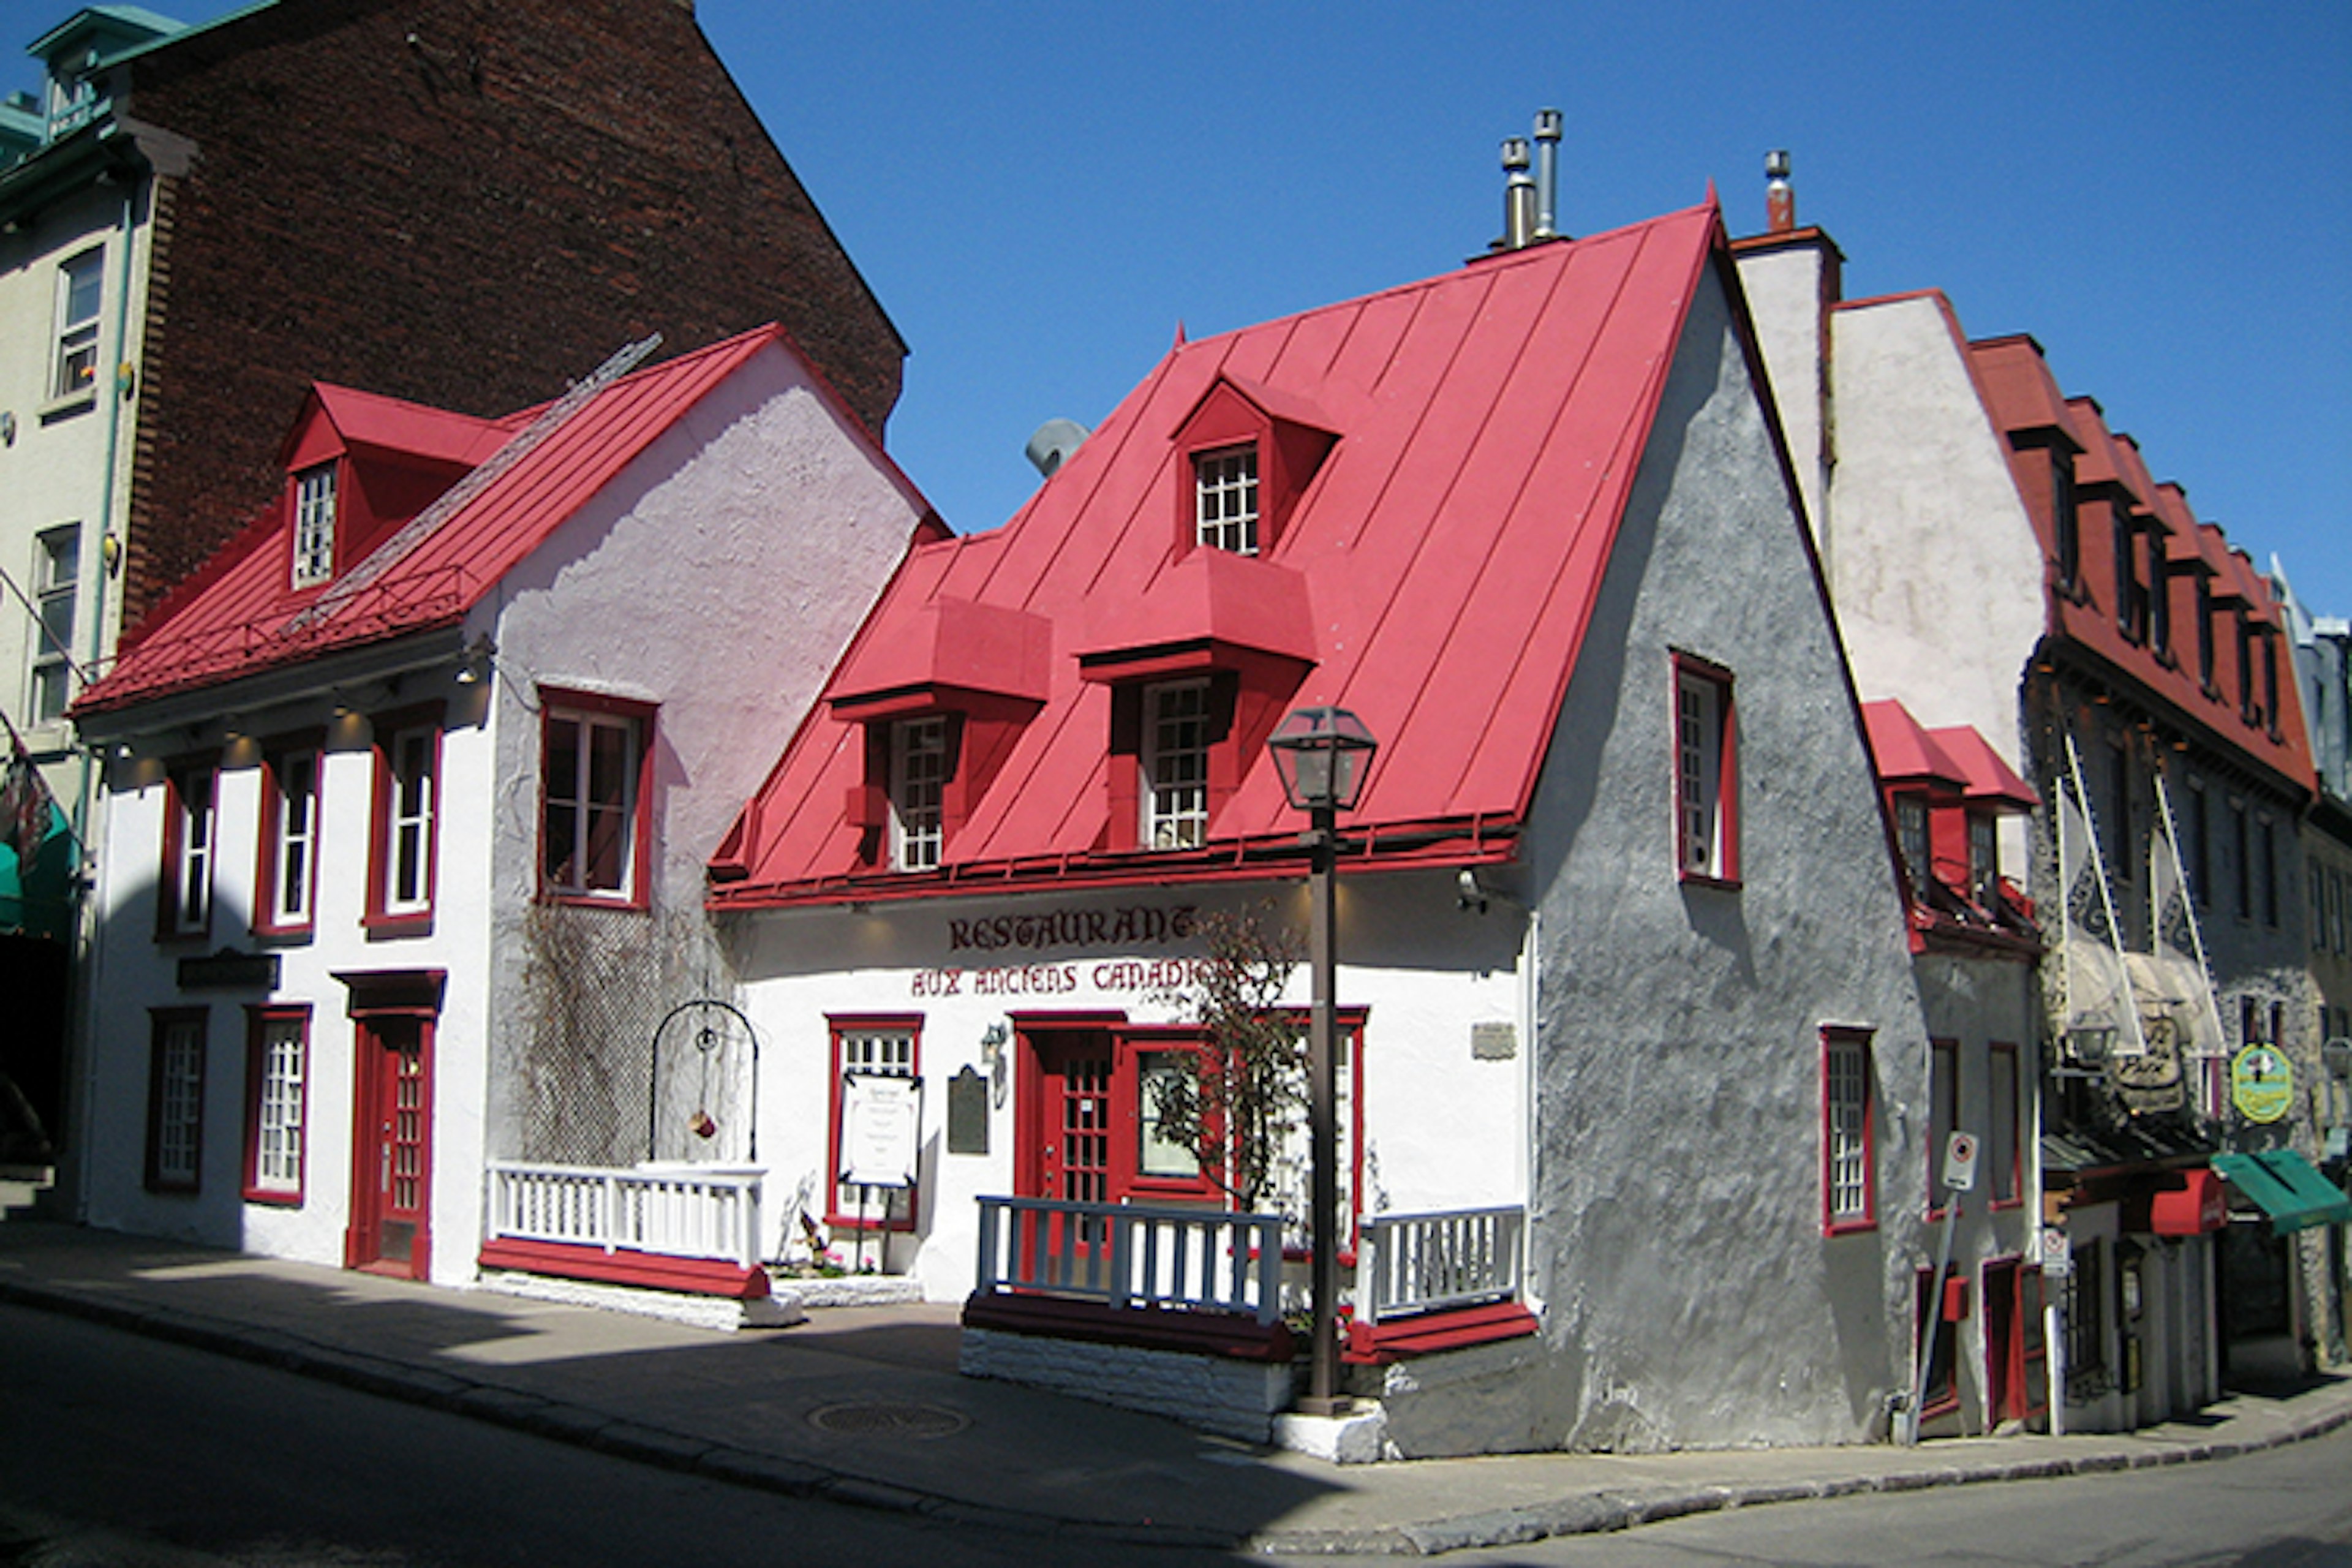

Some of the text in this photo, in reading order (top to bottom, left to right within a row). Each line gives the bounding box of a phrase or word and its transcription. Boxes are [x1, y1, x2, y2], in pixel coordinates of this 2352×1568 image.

[949, 905, 1199, 951] RESTAURANT
[911, 968, 962, 997] AUX
[973, 963, 1078, 995] ANCIENS
